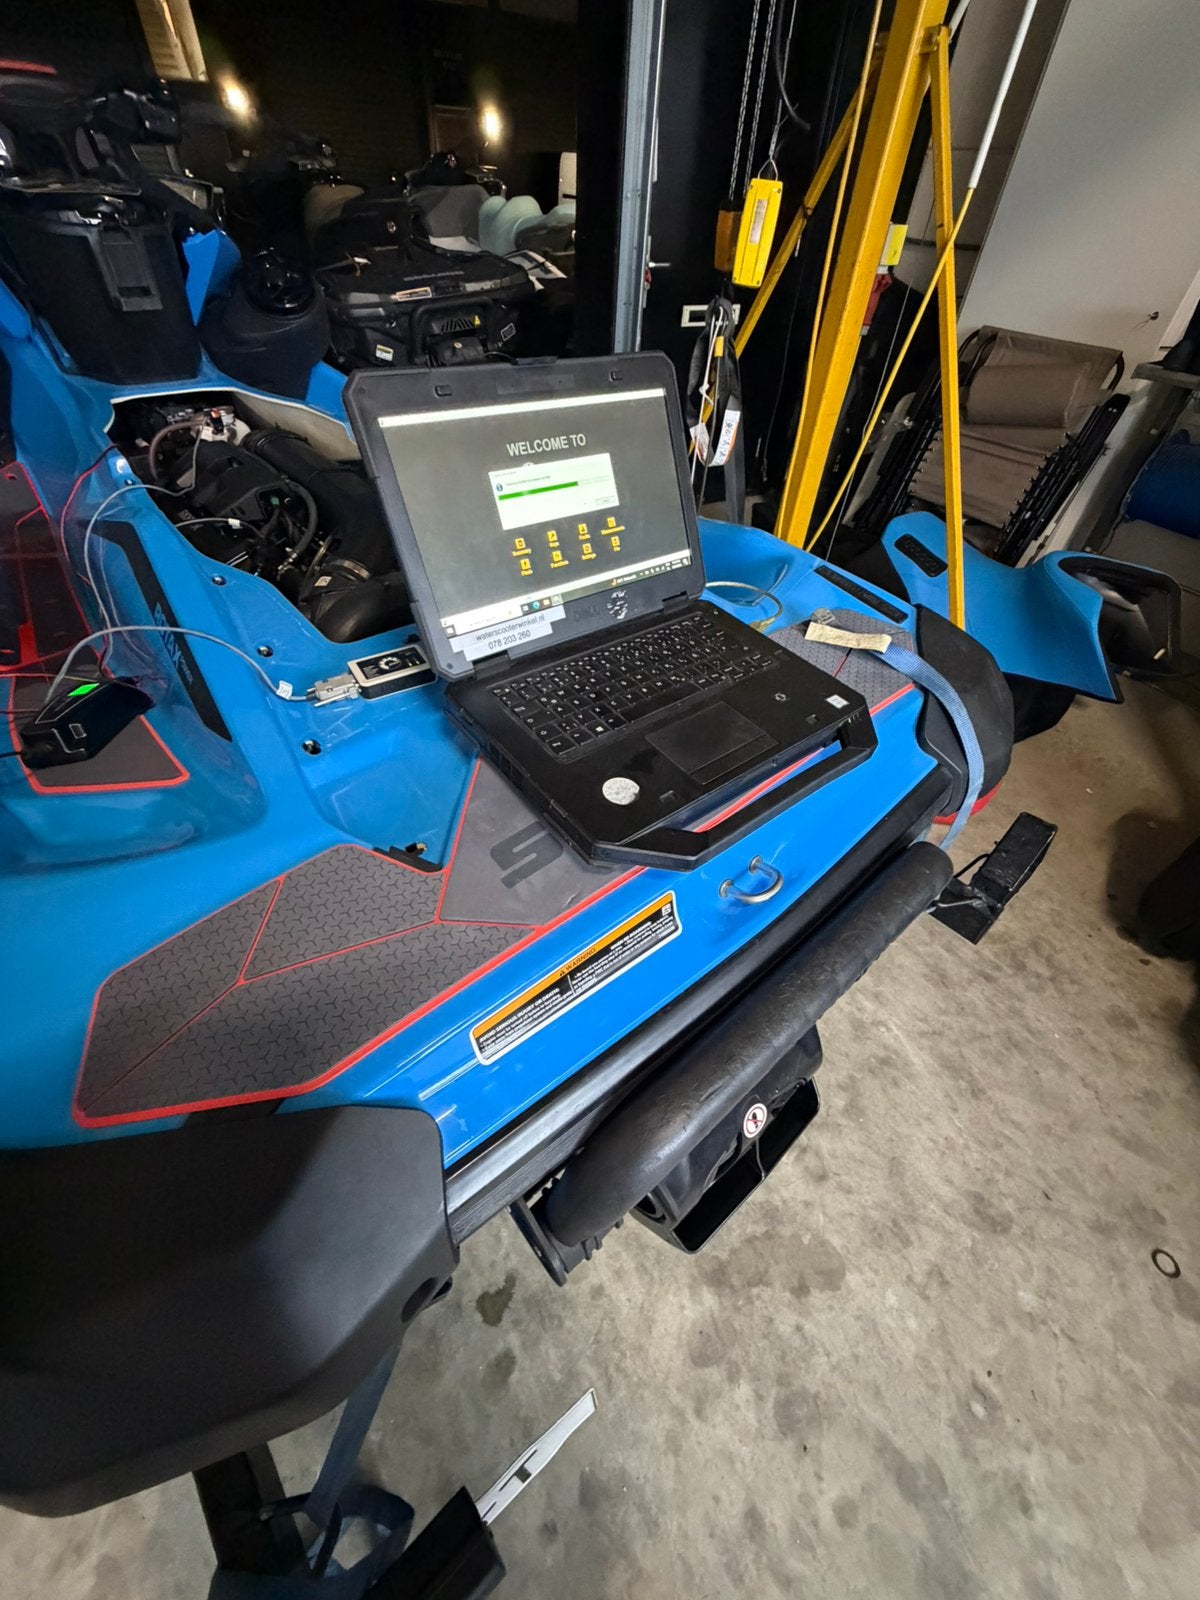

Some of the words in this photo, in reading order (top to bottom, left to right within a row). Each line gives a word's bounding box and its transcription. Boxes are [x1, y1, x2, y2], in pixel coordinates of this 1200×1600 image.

[506, 436, 569, 457] WELCOME
[569, 433, 587, 447] TO
[475, 613, 545, 642] waterscooterwinkel.nl
[487, 637, 502, 650] 078
[502, 633, 517, 645] 203
[517, 628, 531, 640] 260
[490, 821, 563, 889] S
[565, 946, 596, 972] WARNING
